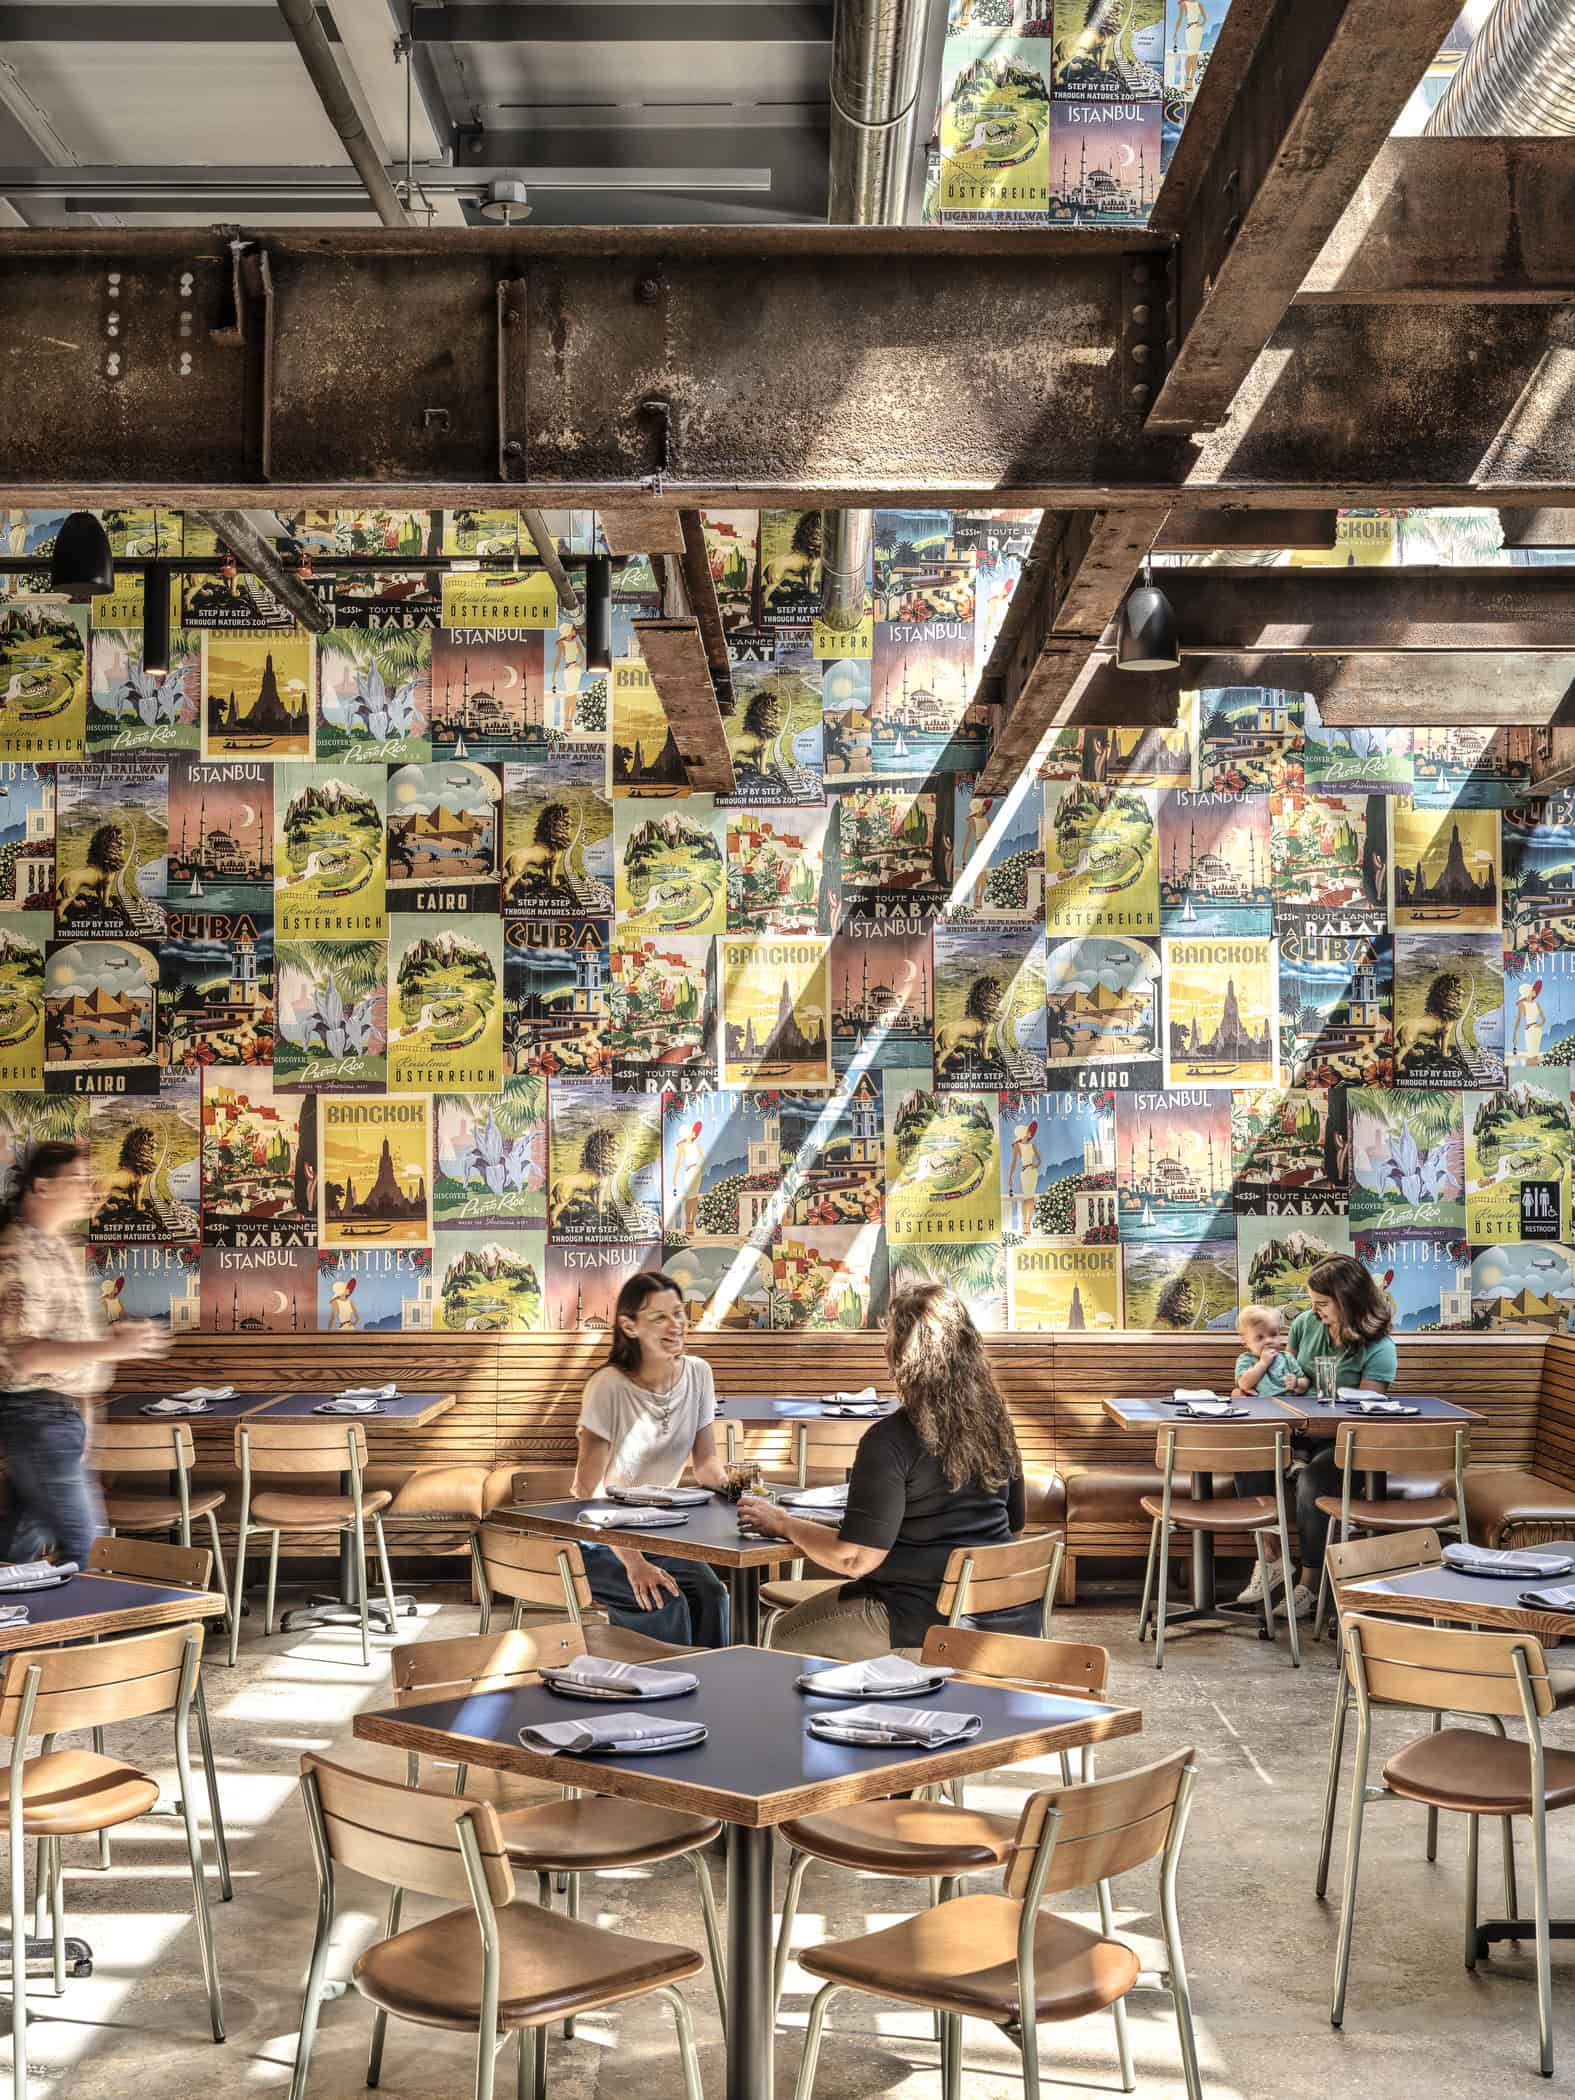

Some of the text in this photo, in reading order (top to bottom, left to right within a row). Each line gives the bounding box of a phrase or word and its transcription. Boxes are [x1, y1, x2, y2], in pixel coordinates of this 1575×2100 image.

[1068, 82, 1120, 91] STEP BY STEP
[1068, 106, 1144, 123] ISTANBUL
[948, 183, 1047, 200] ÖSTERREICH
[198, 609, 250, 617] STEP BY STEP
[368, 606, 401, 614] TOUTE
[450, 604, 549, 618] ÖSTERREICH
[186, 618, 216, 626] THROUGH
[450, 629, 527, 645] ISTANBUL
[890, 623, 967, 642] ISTANBUL
[728, 646, 774, 661] BAT
[113, 725, 177, 749] Puerto Rico
[6, 740, 83, 751] TERREICH
[344, 744, 380, 764] Puerto
[188, 765, 265, 783] ISTANBUL
[1503, 801, 1574, 827] CUB
[416, 893, 468, 910] CAIRO
[504, 908, 536, 916] THROUGH
[1054, 911, 1154, 926] ÖSTERREICH
[1305, 913, 1338, 921] TOUTE
[71, 920, 124, 928] STEP BY STEP
[166, 914, 260, 942] CUBA
[283, 916, 382, 930] ÖSTERREICH
[850, 919, 927, 938] ISTANBUL
[1305, 921, 1387, 936] RABAT
[58, 930, 89, 938] THROUGH
[506, 922, 604, 950] CUBA
[1280, 936, 1380, 963] CUBA
[274, 1056, 306, 1064] DISCOVER
[300, 1056, 365, 1082] Puerto Rico
[396, 1067, 495, 1082] ÖSTERREICH
[645, 1070, 678, 1078] TOUTE
[951, 1072, 1003, 1080] STEP BY STEP
[1410, 1070, 1462, 1078] STEP BY STEP
[75, 1074, 126, 1092] CAIRO
[1078, 1072, 1129, 1088] CAIRO
[1396, 1079, 1427, 1088] THROUGH
[1018, 1092, 1097, 1114] ANTIBES
[1134, 1090, 1212, 1111] ISTANBUL
[328, 1104, 424, 1124] BANGKOK
[434, 1192, 466, 1200] DISCOVER
[460, 1192, 525, 1218] Puerto Rico
[1266, 1201, 1348, 1216] RABAT
[1376, 1202, 1441, 1229] Puerto Rico
[104, 1224, 156, 1232] STEP BY STEP
[895, 1218, 994, 1232] ÖSTERREICH
[236, 1232, 318, 1247] RABAT
[105, 1248, 185, 1270] ANTIBES
[220, 1250, 298, 1270] ISTANBUL
[564, 1249, 641, 1270] ISTANBUL
[1374, 1241, 1454, 1264] ANTIBES
[337, 1250, 416, 1272] ANTIBES
[1016, 1252, 1115, 1272] BANGKOK
